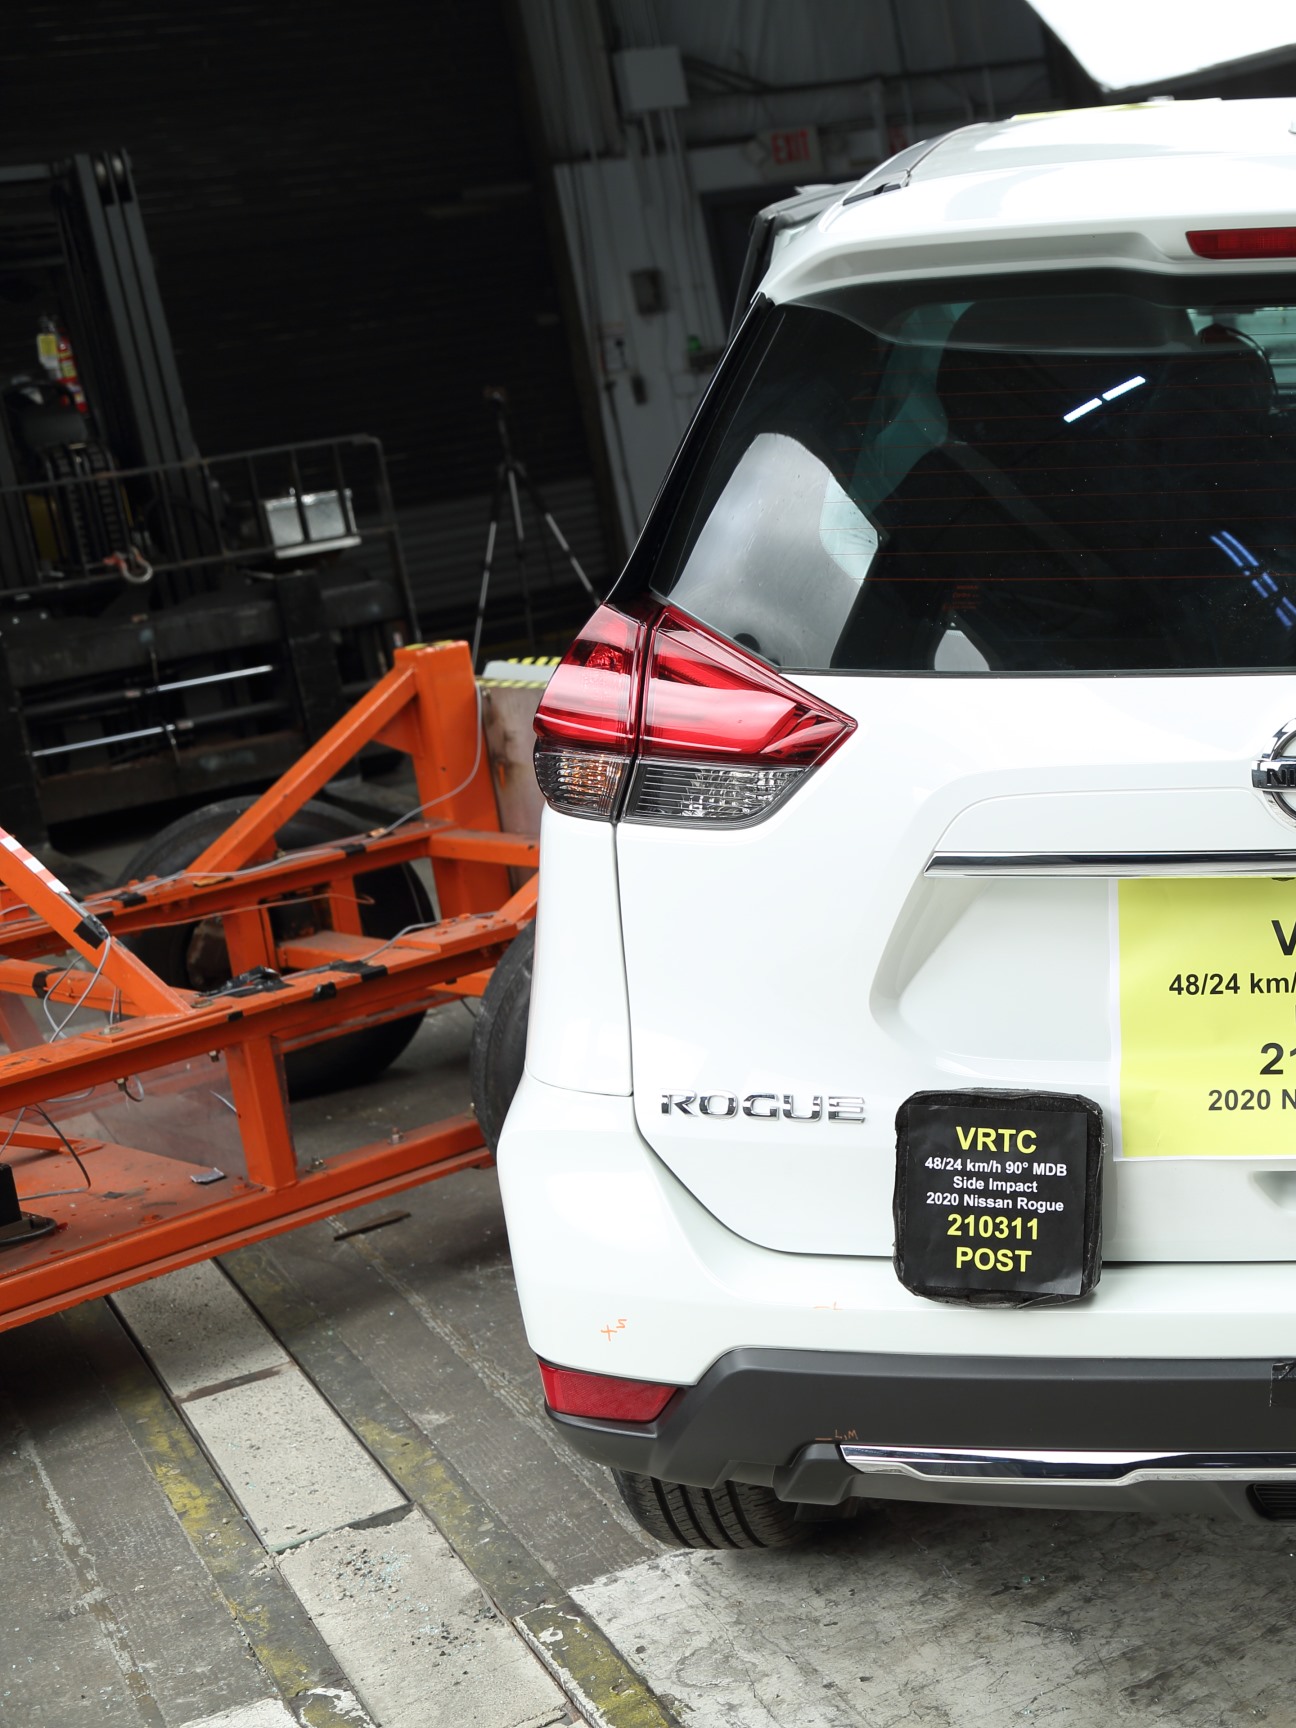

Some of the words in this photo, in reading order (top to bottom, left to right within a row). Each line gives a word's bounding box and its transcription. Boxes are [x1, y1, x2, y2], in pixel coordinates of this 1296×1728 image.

[771, 129, 812, 166] EXIT
[1168, 973, 1241, 996] 48/24
[660, 1088, 866, 1123] ROGUE
[1208, 1089, 1271, 1111] 2020
[956, 1126, 1037, 1154] VRTC
[924, 1157, 963, 1171] 48/24
[966, 1159, 1001, 1174] km/h
[1005, 1161, 1029, 1175] 90°
[1032, 1163, 1068, 1177] MDB
[953, 1176, 985, 1190] Side
[988, 1178, 1038, 1194] Impact
[926, 1192, 960, 1207] 2020
[963, 1194, 1013, 1210] Nissan
[1016, 1197, 1065, 1214] Rogue
[946, 1213, 1039, 1241] 210311
[955, 1246, 1033, 1273] POST
